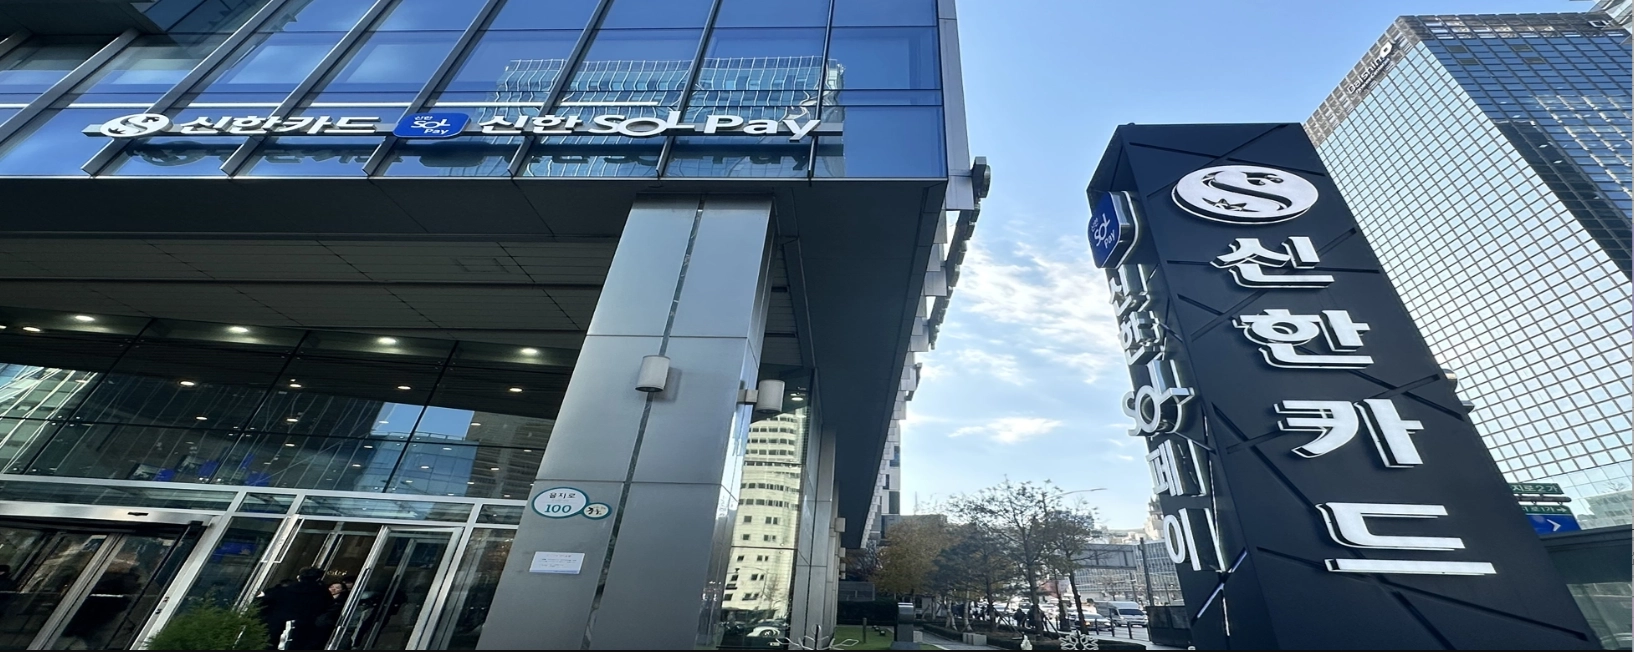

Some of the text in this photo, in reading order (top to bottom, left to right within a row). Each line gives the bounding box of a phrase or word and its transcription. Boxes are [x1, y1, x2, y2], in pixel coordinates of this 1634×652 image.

[179, 114, 382, 135] 신한카드
[410, 118, 450, 128] SOL
[478, 114, 583, 135] 신한
[703, 114, 822, 142] Pay
[1093, 212, 1111, 247] SOL
[1103, 229, 1116, 249] Pay
[1209, 236, 1497, 575] 신한카드
[1511, 484, 1559, 492] 지로2가
[544, 504, 572, 513] 100
